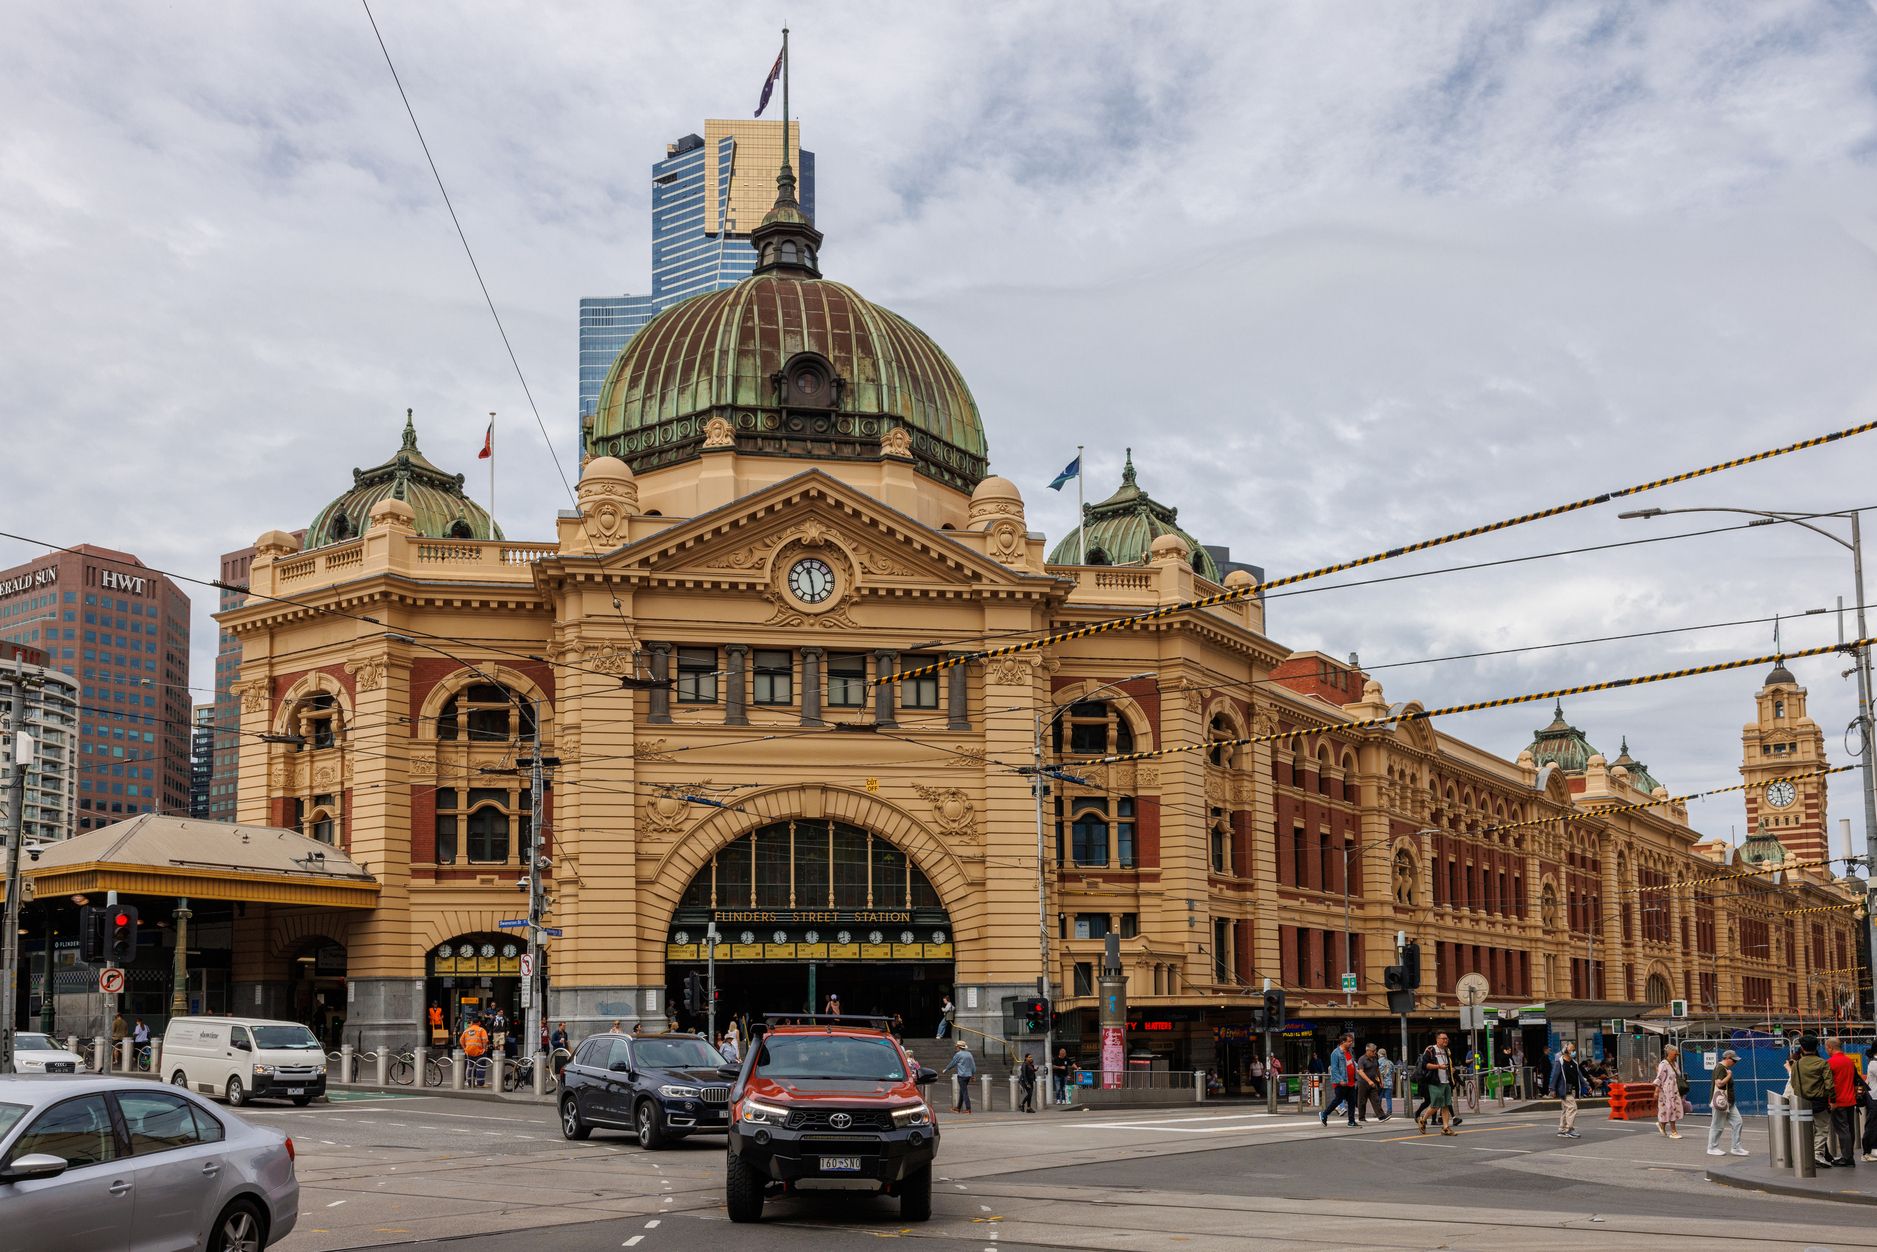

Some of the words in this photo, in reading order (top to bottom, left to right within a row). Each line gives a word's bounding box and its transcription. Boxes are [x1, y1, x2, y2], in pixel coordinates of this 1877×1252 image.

[35, 567, 57, 585] SUN
[102, 570, 145, 594] HWT
[715, 911, 777, 922] FLINDERS
[793, 911, 840, 922] STREET
[854, 911, 910, 922] STATION
